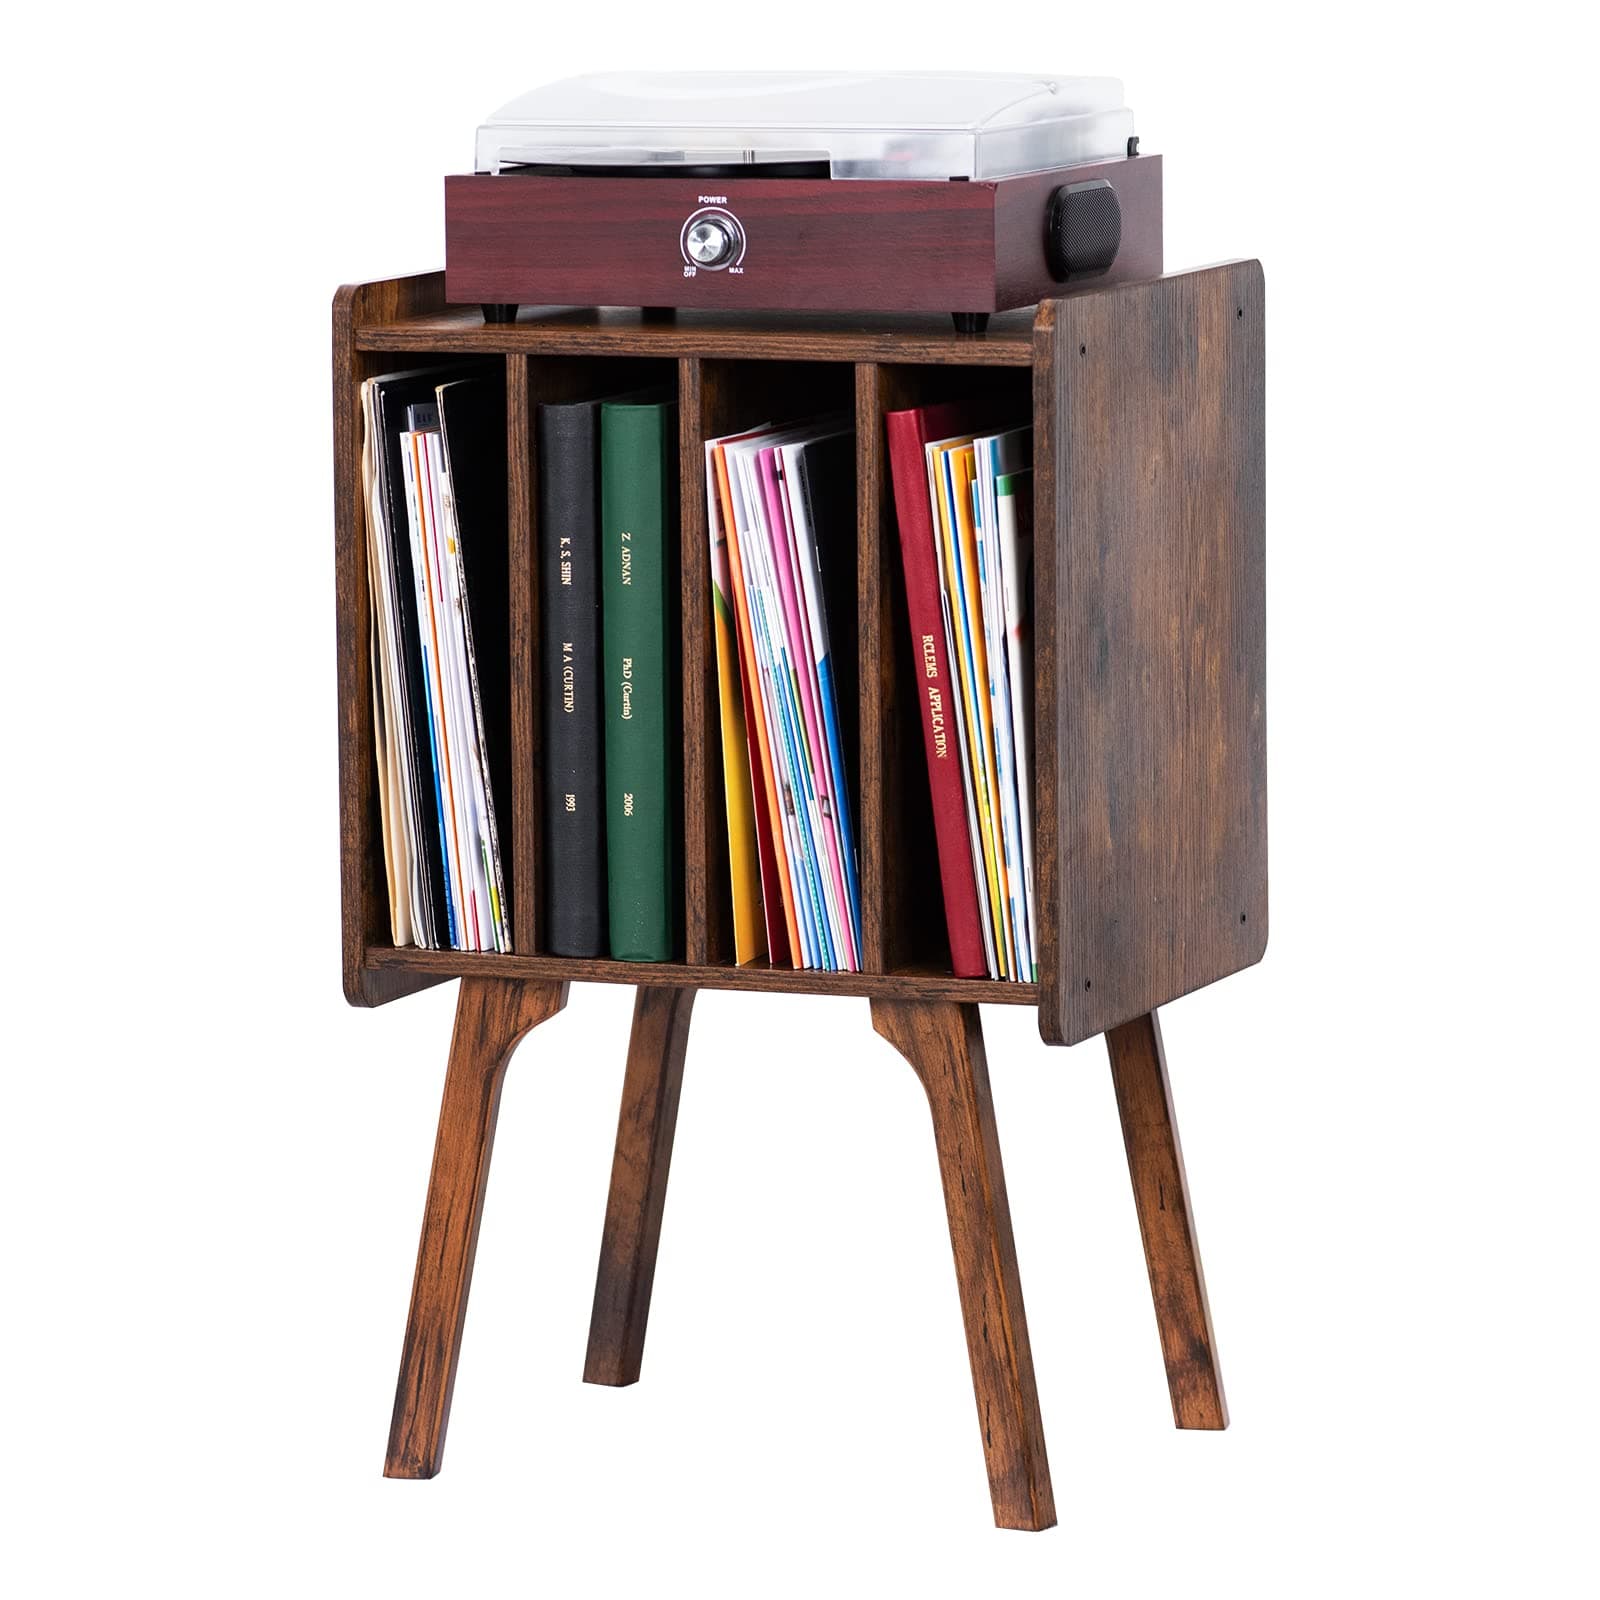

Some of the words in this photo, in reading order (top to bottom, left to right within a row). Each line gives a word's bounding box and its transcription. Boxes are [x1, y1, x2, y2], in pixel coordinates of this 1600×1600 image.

[698, 196, 727, 204] POWER
[560, 537, 571, 548] K.
[561, 561, 572, 585] SHIN
[621, 546, 632, 585] ADNAN
[562, 642, 573, 652] M
[563, 655, 573, 663] A
[922, 634, 938, 678] RCLEMS
[622, 657, 632, 679] PhD
[563, 666, 575, 713] (CURTIN)
[620, 681, 633, 720] (Curtin)
[928, 686, 947, 758] APPLICATION
[565, 794, 576, 811] 1993
[623, 792, 634, 816] 2006
